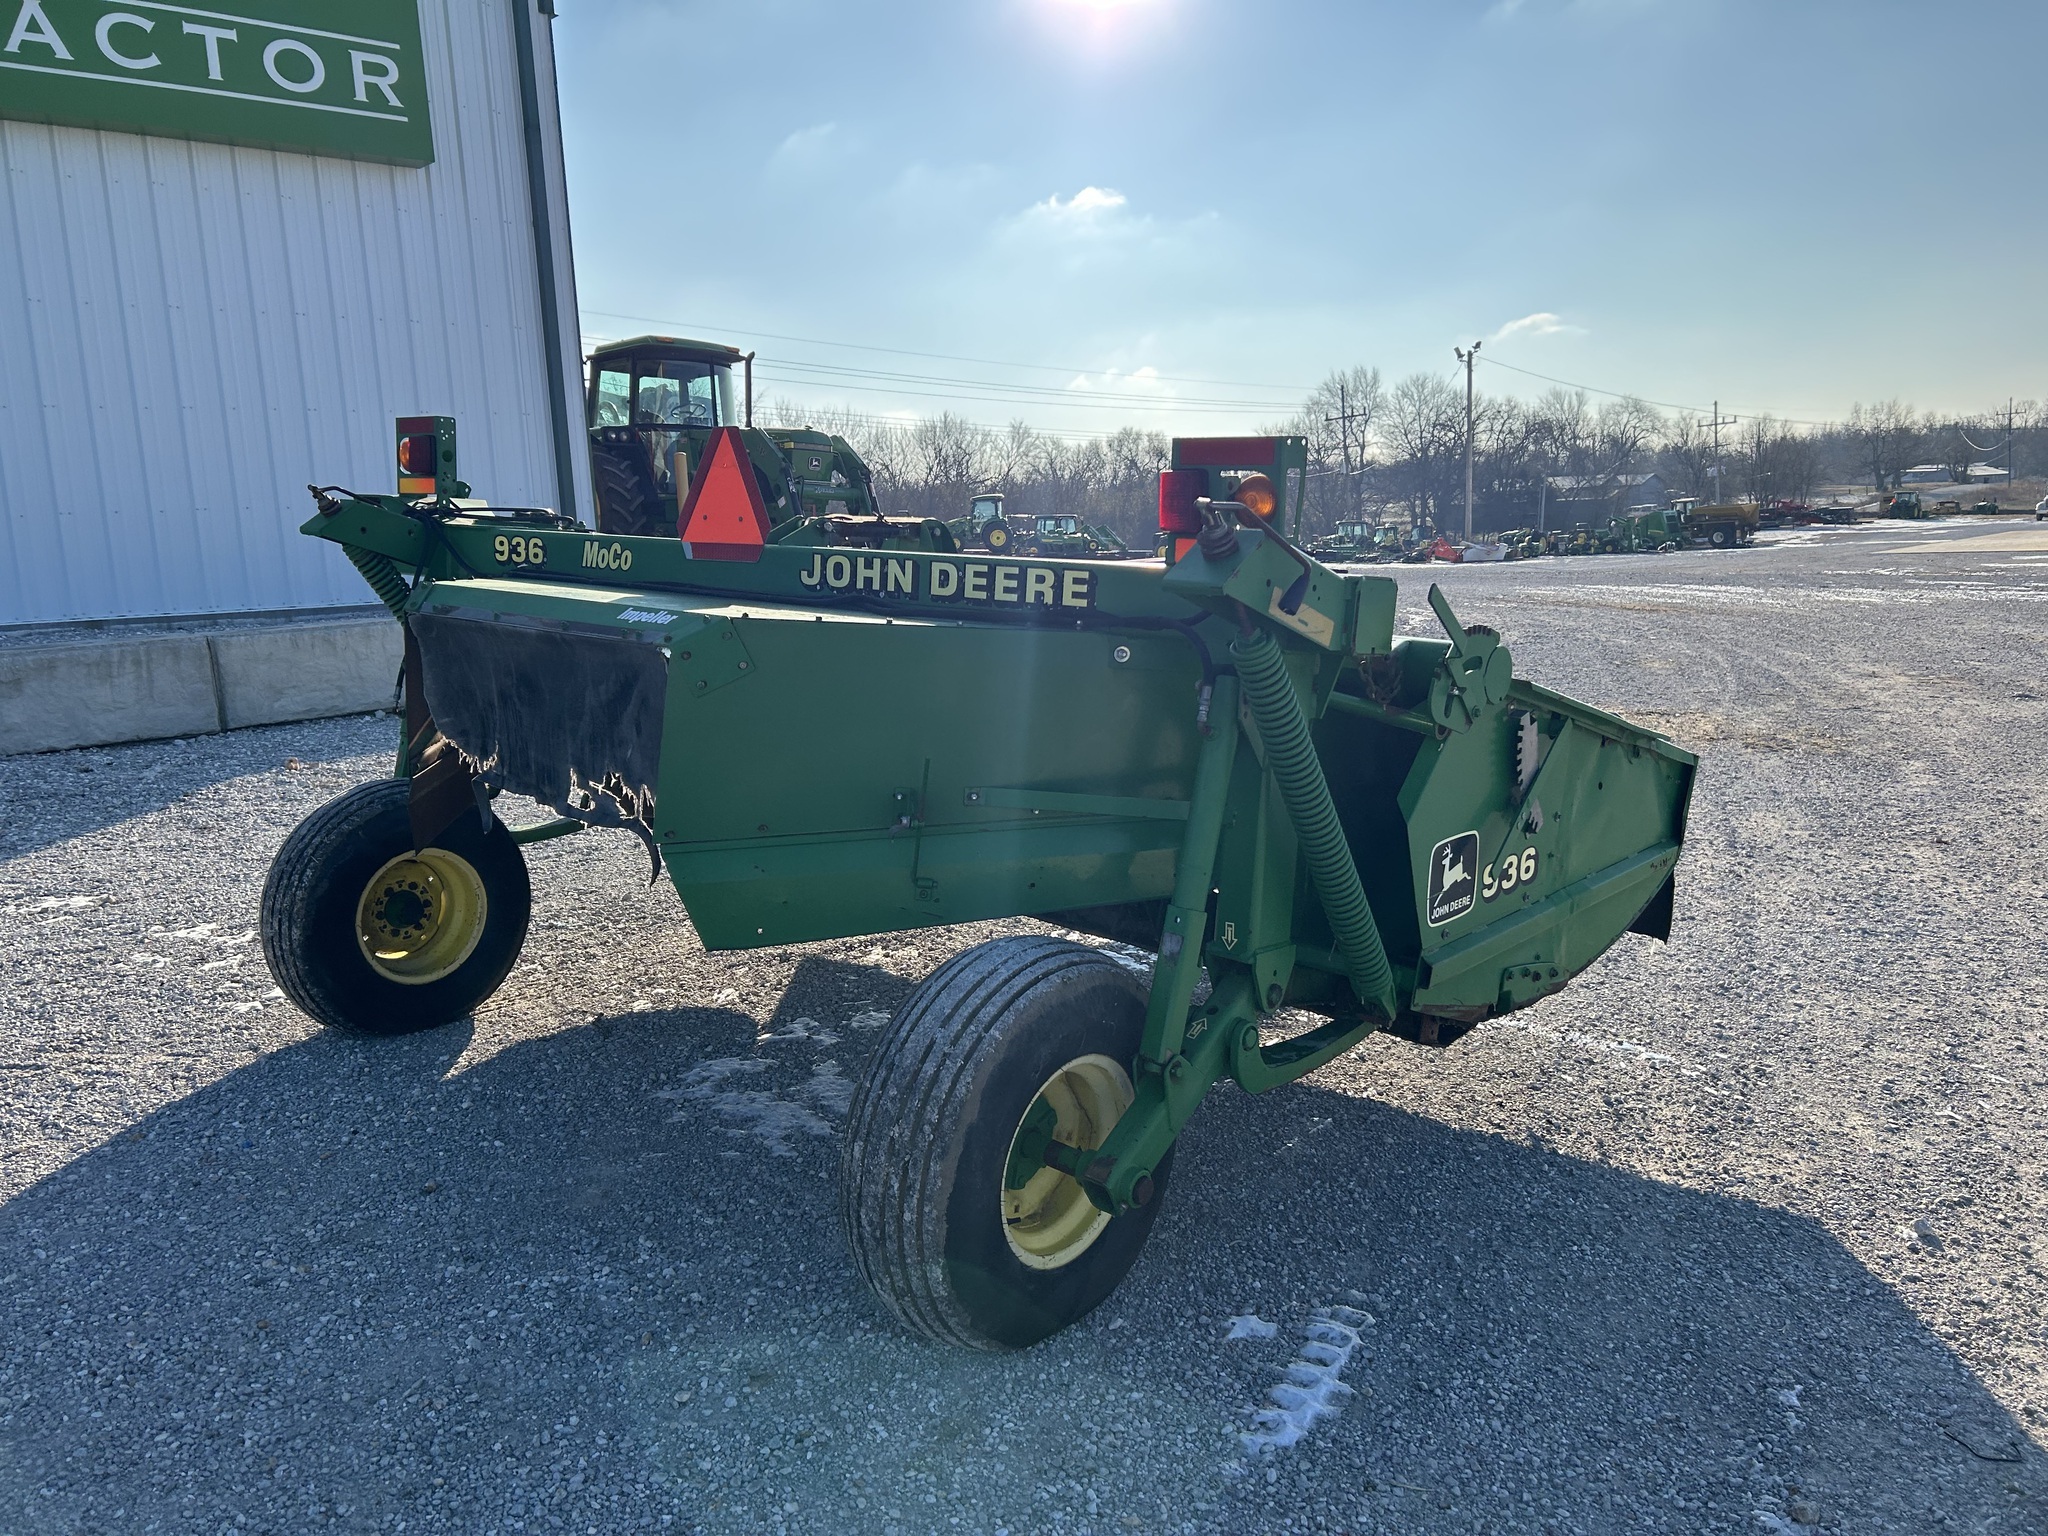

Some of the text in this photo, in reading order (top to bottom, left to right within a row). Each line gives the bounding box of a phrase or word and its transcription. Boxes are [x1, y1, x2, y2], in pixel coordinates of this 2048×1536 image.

[3, 0, 404, 107] ACTOR
[494, 535, 544, 565] 936
[582, 540, 632, 571] MoCo
[800, 554, 1090, 608] JOHN DEERE
[616, 607, 679, 625] Impeller
[1431, 895, 1471, 919] JOHN DEERE
